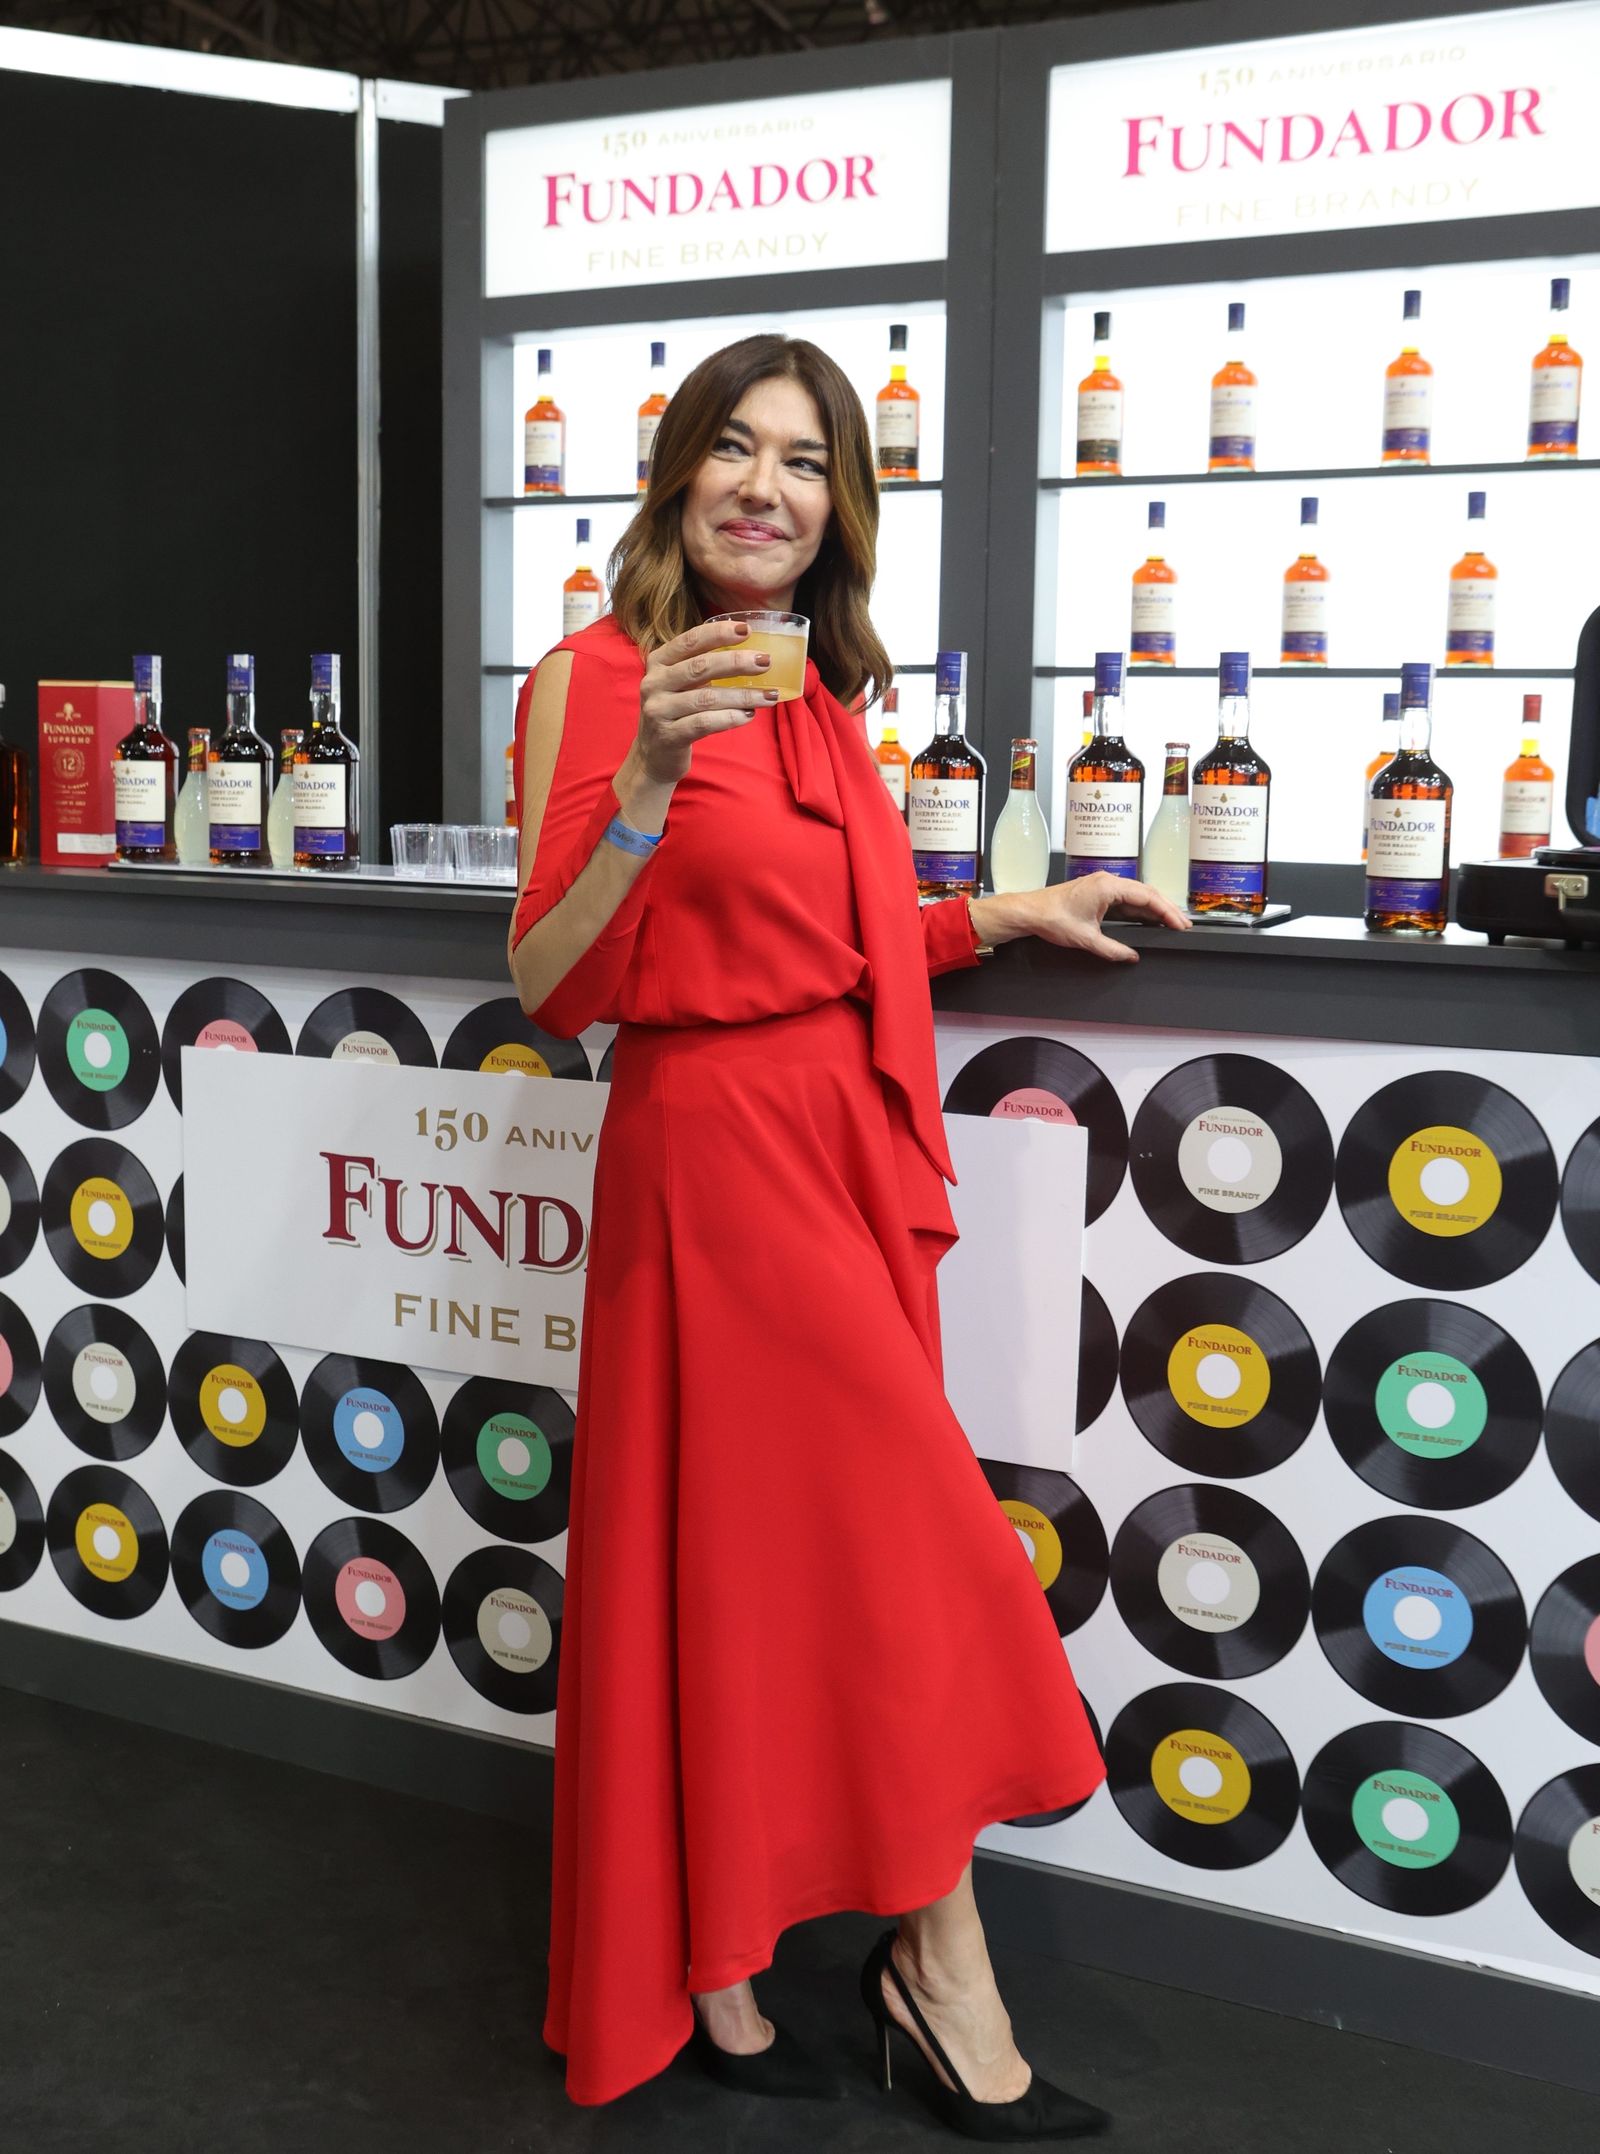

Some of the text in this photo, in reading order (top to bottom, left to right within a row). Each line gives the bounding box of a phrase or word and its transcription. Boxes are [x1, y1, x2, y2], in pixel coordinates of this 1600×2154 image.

[1199, 46, 1466, 96] 150 ANIVERSARIO
[603, 117, 815, 156] 150 ANIVERSARIO
[1121, 87, 1546, 178] FUNDADOR
[543, 155, 879, 229] FUNDADOR
[1177, 178, 1481, 228] FINE BRANDY
[587, 232, 830, 273] FINE BRANDY
[43, 723, 94, 735] FUNDADOR
[63, 757, 75, 770] 12
[116, 777, 157, 786] NDADOR
[209, 779, 252, 788] NDADOR
[293, 781, 336, 790] NDADOR
[911, 795, 970, 809] FUNDADOR
[1069, 799, 1133, 813] FUNDADOR
[1193, 802, 1259, 817] FUNDADOR
[77, 1019, 116, 1032] FUNDADOR
[204, 1031, 247, 1044] FUNDADOR
[342, 1043, 388, 1056] FUNDADOR
[491, 1056, 540, 1070] FUNDADOR
[1003, 1101, 1064, 1118] FUNDADOR
[415, 1106, 594, 1153] 150 ANIV
[1198, 1120, 1264, 1137] FUNDADOR
[1410, 1141, 1482, 1158] FUNDADOR
[81, 1188, 121, 1201] FUNDADOR
[1198, 1187, 1261, 1200] FINE BRANDY
[319, 1151, 588, 1273] FUND
[394, 1292, 577, 1352] FINE B
[1187, 1336, 1252, 1356] FUNDADOR
[83, 1352, 124, 1367] FUNDADOR
[210, 1374, 254, 1389] FUNDADOR
[1397, 1364, 1468, 1384] FUNDADOR
[345, 1397, 391, 1413] FUNDADOR
[490, 1423, 537, 1440] FUNDADOR
[86, 1512, 126, 1528] FUNDADOR
[1008, 1517, 1045, 1530] DADOR
[213, 1538, 255, 1555] FUNDADOR
[1177, 1544, 1242, 1564] FUNDADOR
[347, 1567, 392, 1583] FUNDADOR
[1385, 1578, 1454, 1598] FUNDADOR
[490, 1597, 538, 1616] FUNDADOR
[1177, 1606, 1239, 1623] FINE BRANDY
[1170, 1739, 1233, 1761] FUNDADOR
[1373, 1780, 1441, 1802] FUNDADOR
